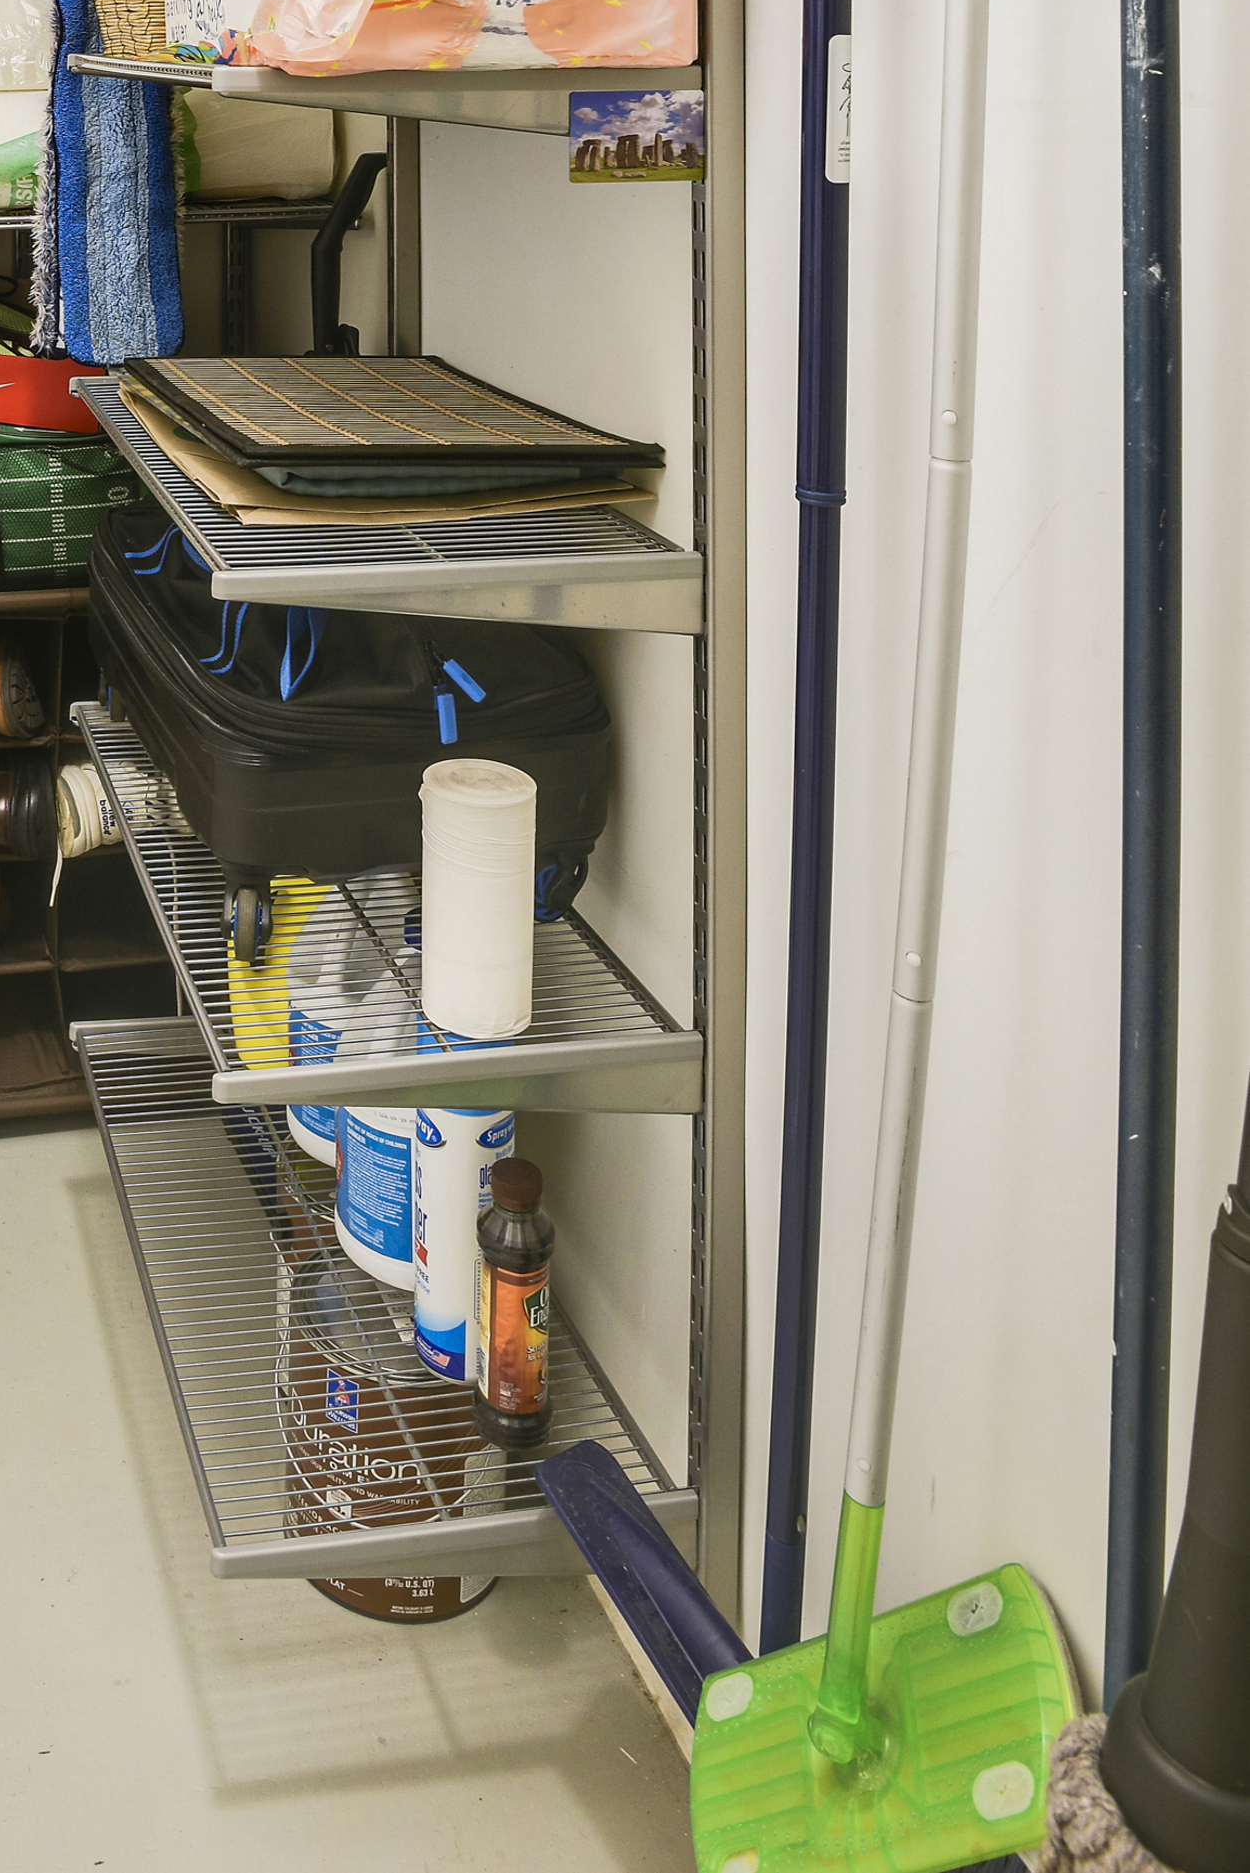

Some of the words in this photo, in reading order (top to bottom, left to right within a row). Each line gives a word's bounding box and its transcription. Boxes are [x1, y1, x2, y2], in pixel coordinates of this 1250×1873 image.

[100, 799, 112, 835] balance
[384, 1139, 407, 1150] CHILDREN
[405, 1579, 420, 1588] U.S.
[422, 1579, 434, 1588] QT)
[411, 1588, 428, 1598] 3.63
